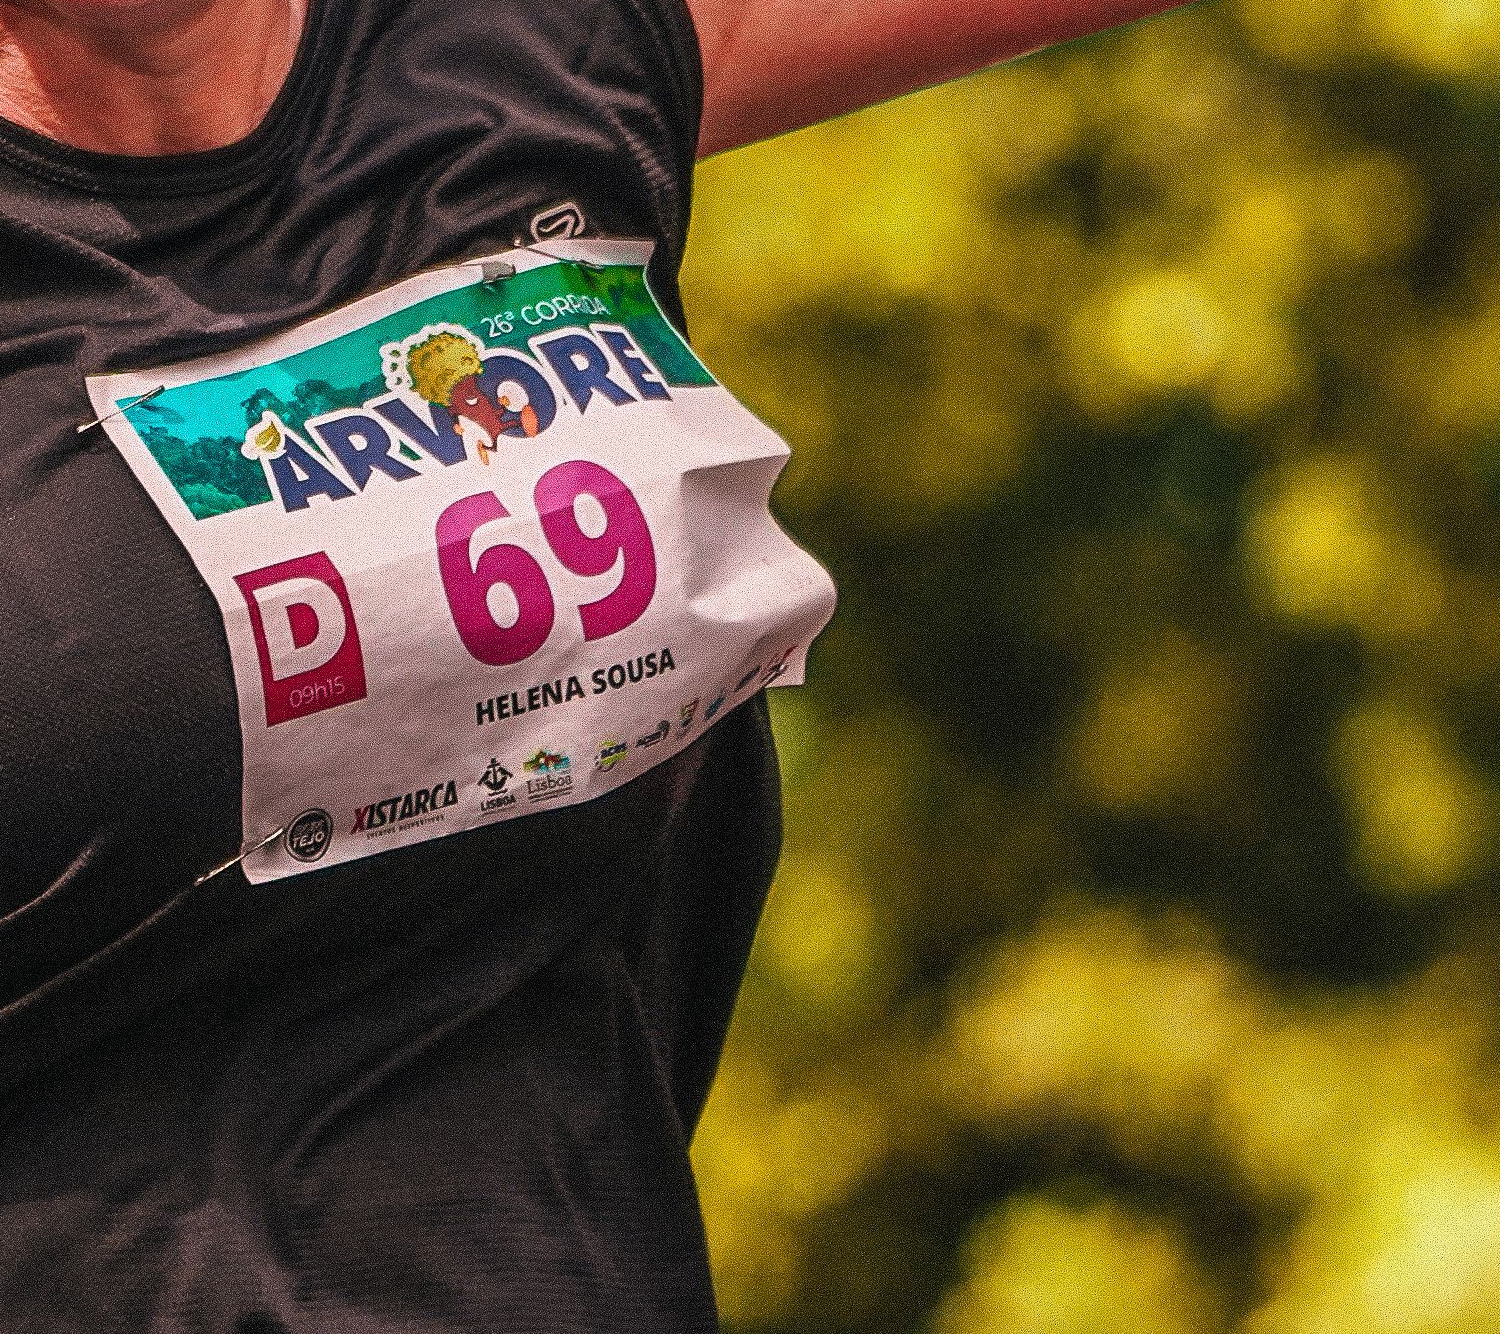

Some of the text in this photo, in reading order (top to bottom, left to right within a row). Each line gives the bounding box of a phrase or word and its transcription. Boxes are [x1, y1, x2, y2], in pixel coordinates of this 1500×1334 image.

[434, 459, 658, 667] 69
[252, 577, 347, 682] D
[289, 676, 345, 709] 09h15
[475, 675, 586, 726] HELENA
[591, 647, 676, 695] SOUSA
[350, 779, 459, 836] XISTARCA
[525, 774, 573, 795] Lisboa
